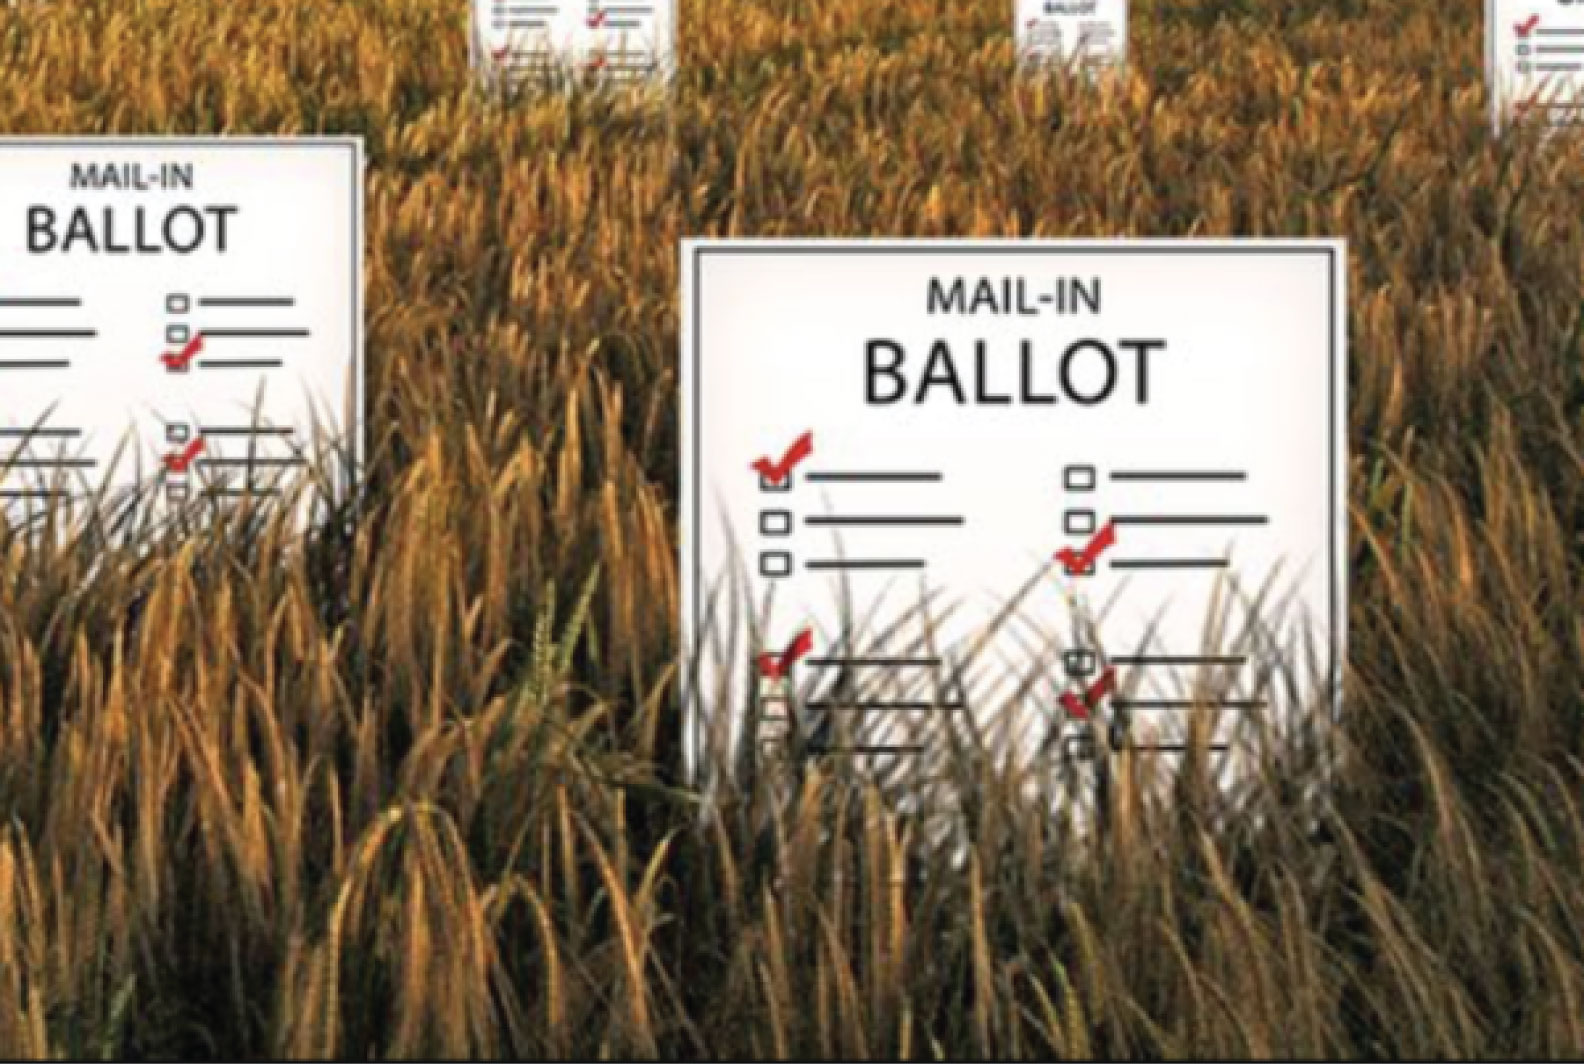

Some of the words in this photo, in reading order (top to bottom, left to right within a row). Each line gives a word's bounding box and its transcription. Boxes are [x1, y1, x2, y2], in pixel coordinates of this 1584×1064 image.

[69, 162, 194, 190] MAIL-IN
[26, 203, 240, 255] BALLOT
[926, 276, 1102, 316] MAIL-IN
[863, 337, 1167, 406] BALLOT
